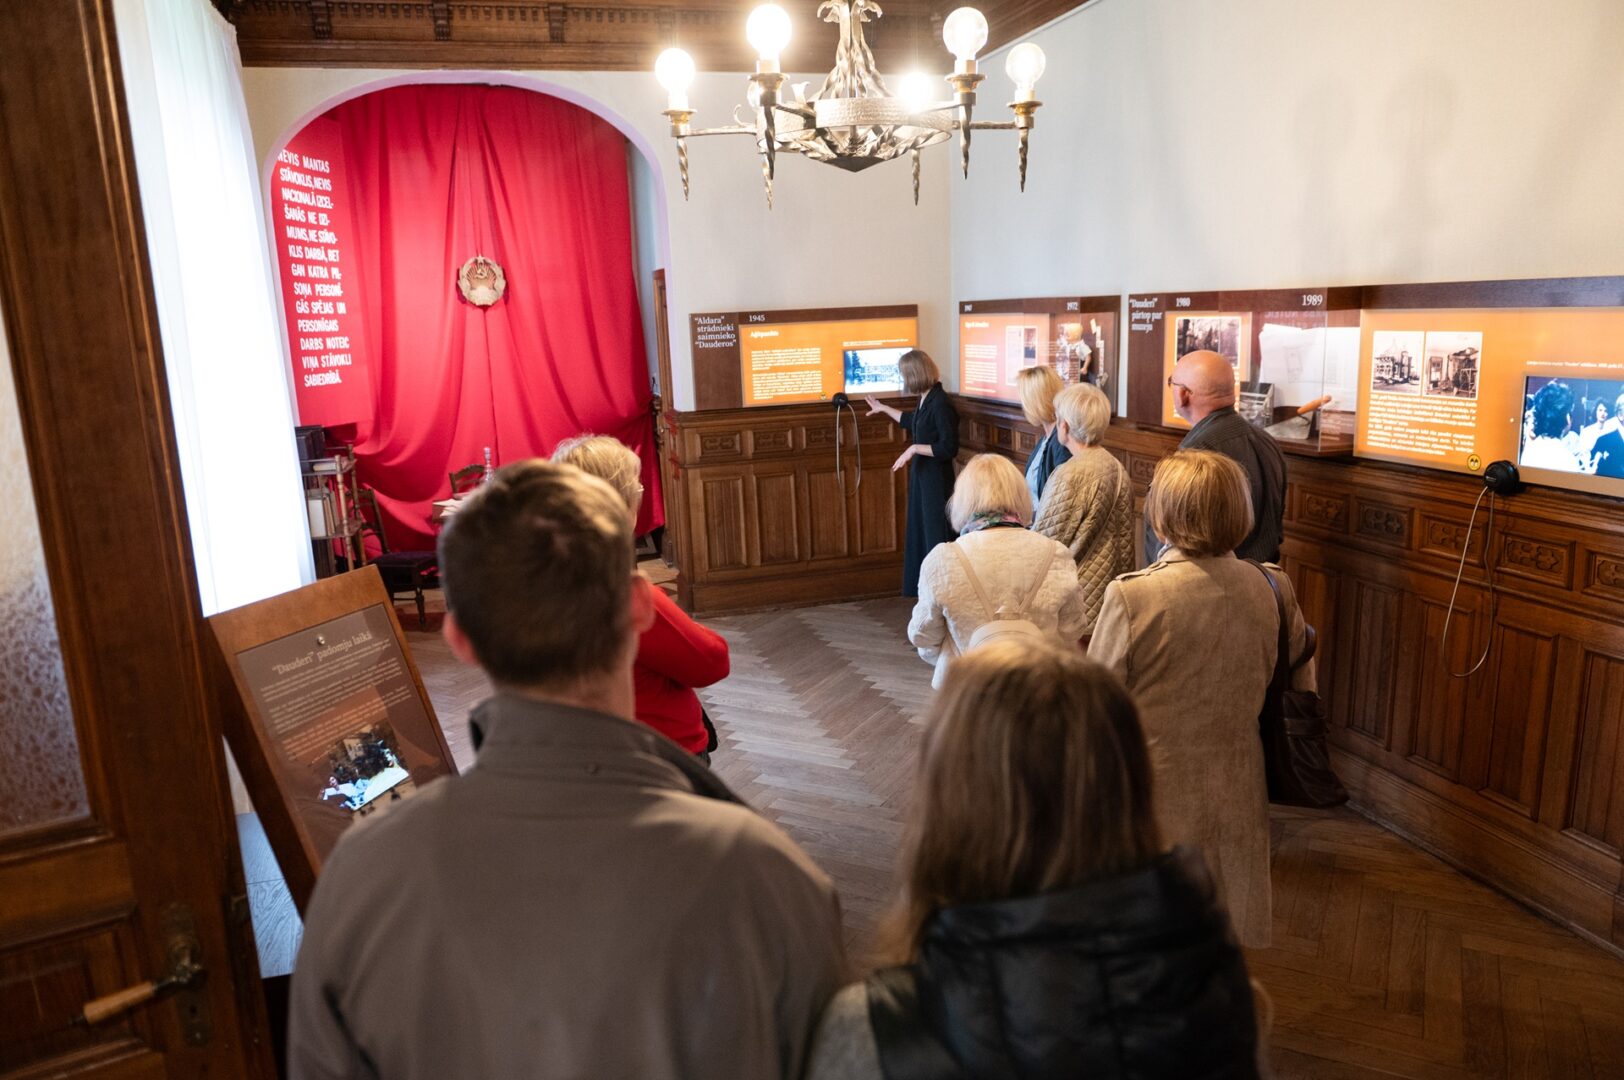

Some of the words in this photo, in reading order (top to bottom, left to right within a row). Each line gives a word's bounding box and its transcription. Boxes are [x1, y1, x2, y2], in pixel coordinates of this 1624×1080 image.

[302, 156, 329, 173] MANTAS
[314, 176, 331, 191] NEVIS
[284, 204, 306, 222] ŠANĀS
[308, 212, 317, 223] NE
[308, 230, 318, 242] NE
[292, 264, 305, 276] GAN
[308, 266, 328, 278] KATRA
[294, 282, 312, 298] SOŅA
[296, 298, 309, 314] GĀS
[310, 298, 334, 314] SPĒJAS
[336, 302, 347, 314] UN
[1302, 294, 1323, 305] 1989
[300, 338, 323, 350] DARBS
[326, 336, 349, 349] NOTEIC
[302, 356, 319, 372] VIŅA
[320, 352, 352, 367] STĀVOKLI
